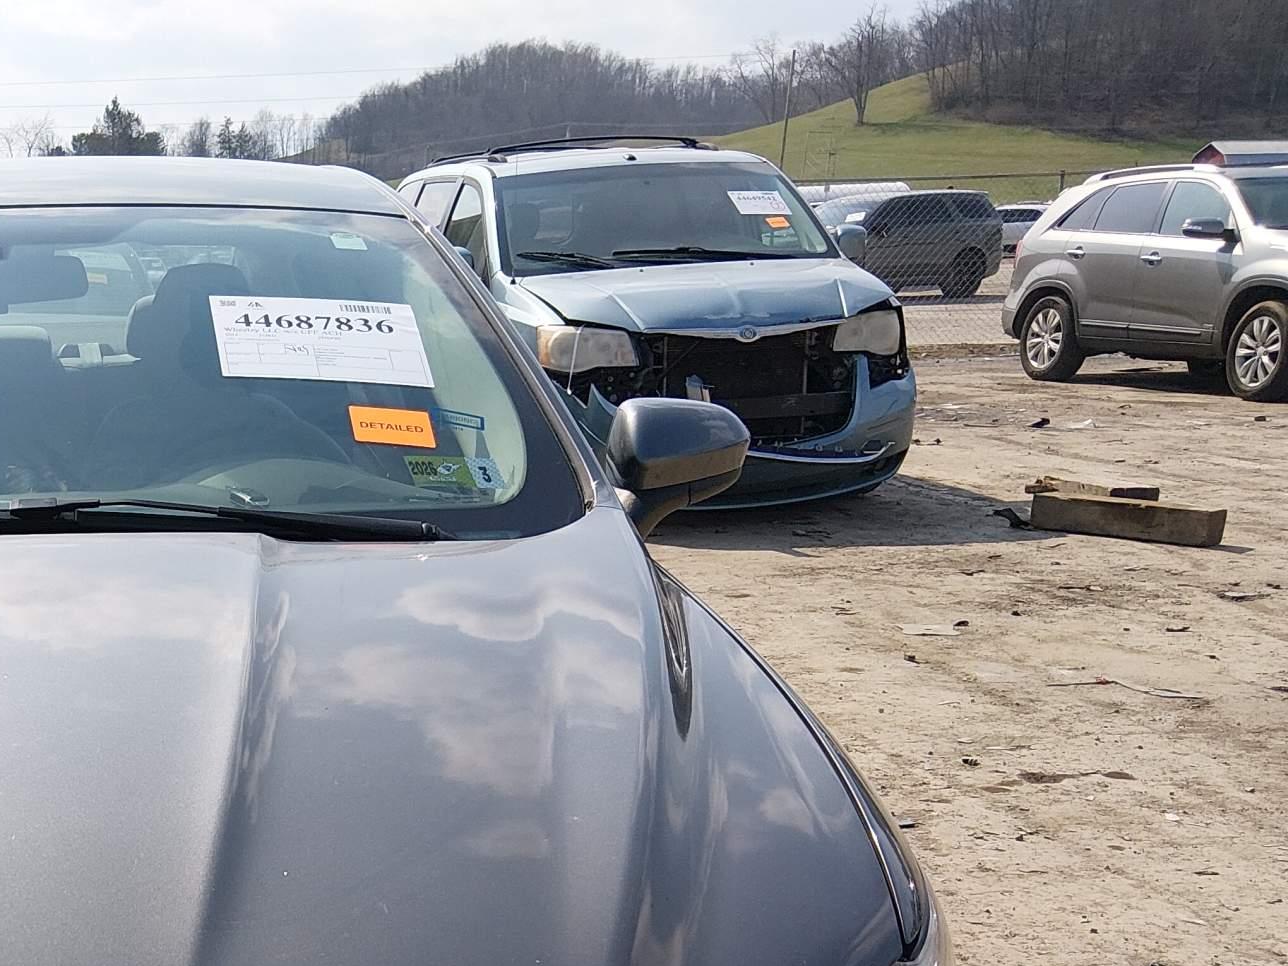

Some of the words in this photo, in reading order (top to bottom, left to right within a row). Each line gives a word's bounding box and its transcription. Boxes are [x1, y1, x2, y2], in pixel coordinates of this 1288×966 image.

[235, 313, 394, 334] 44687836
[360, 421, 424, 433] DETAILED
[408, 461, 437, 475] 2026
[478, 466, 492, 483] 3
